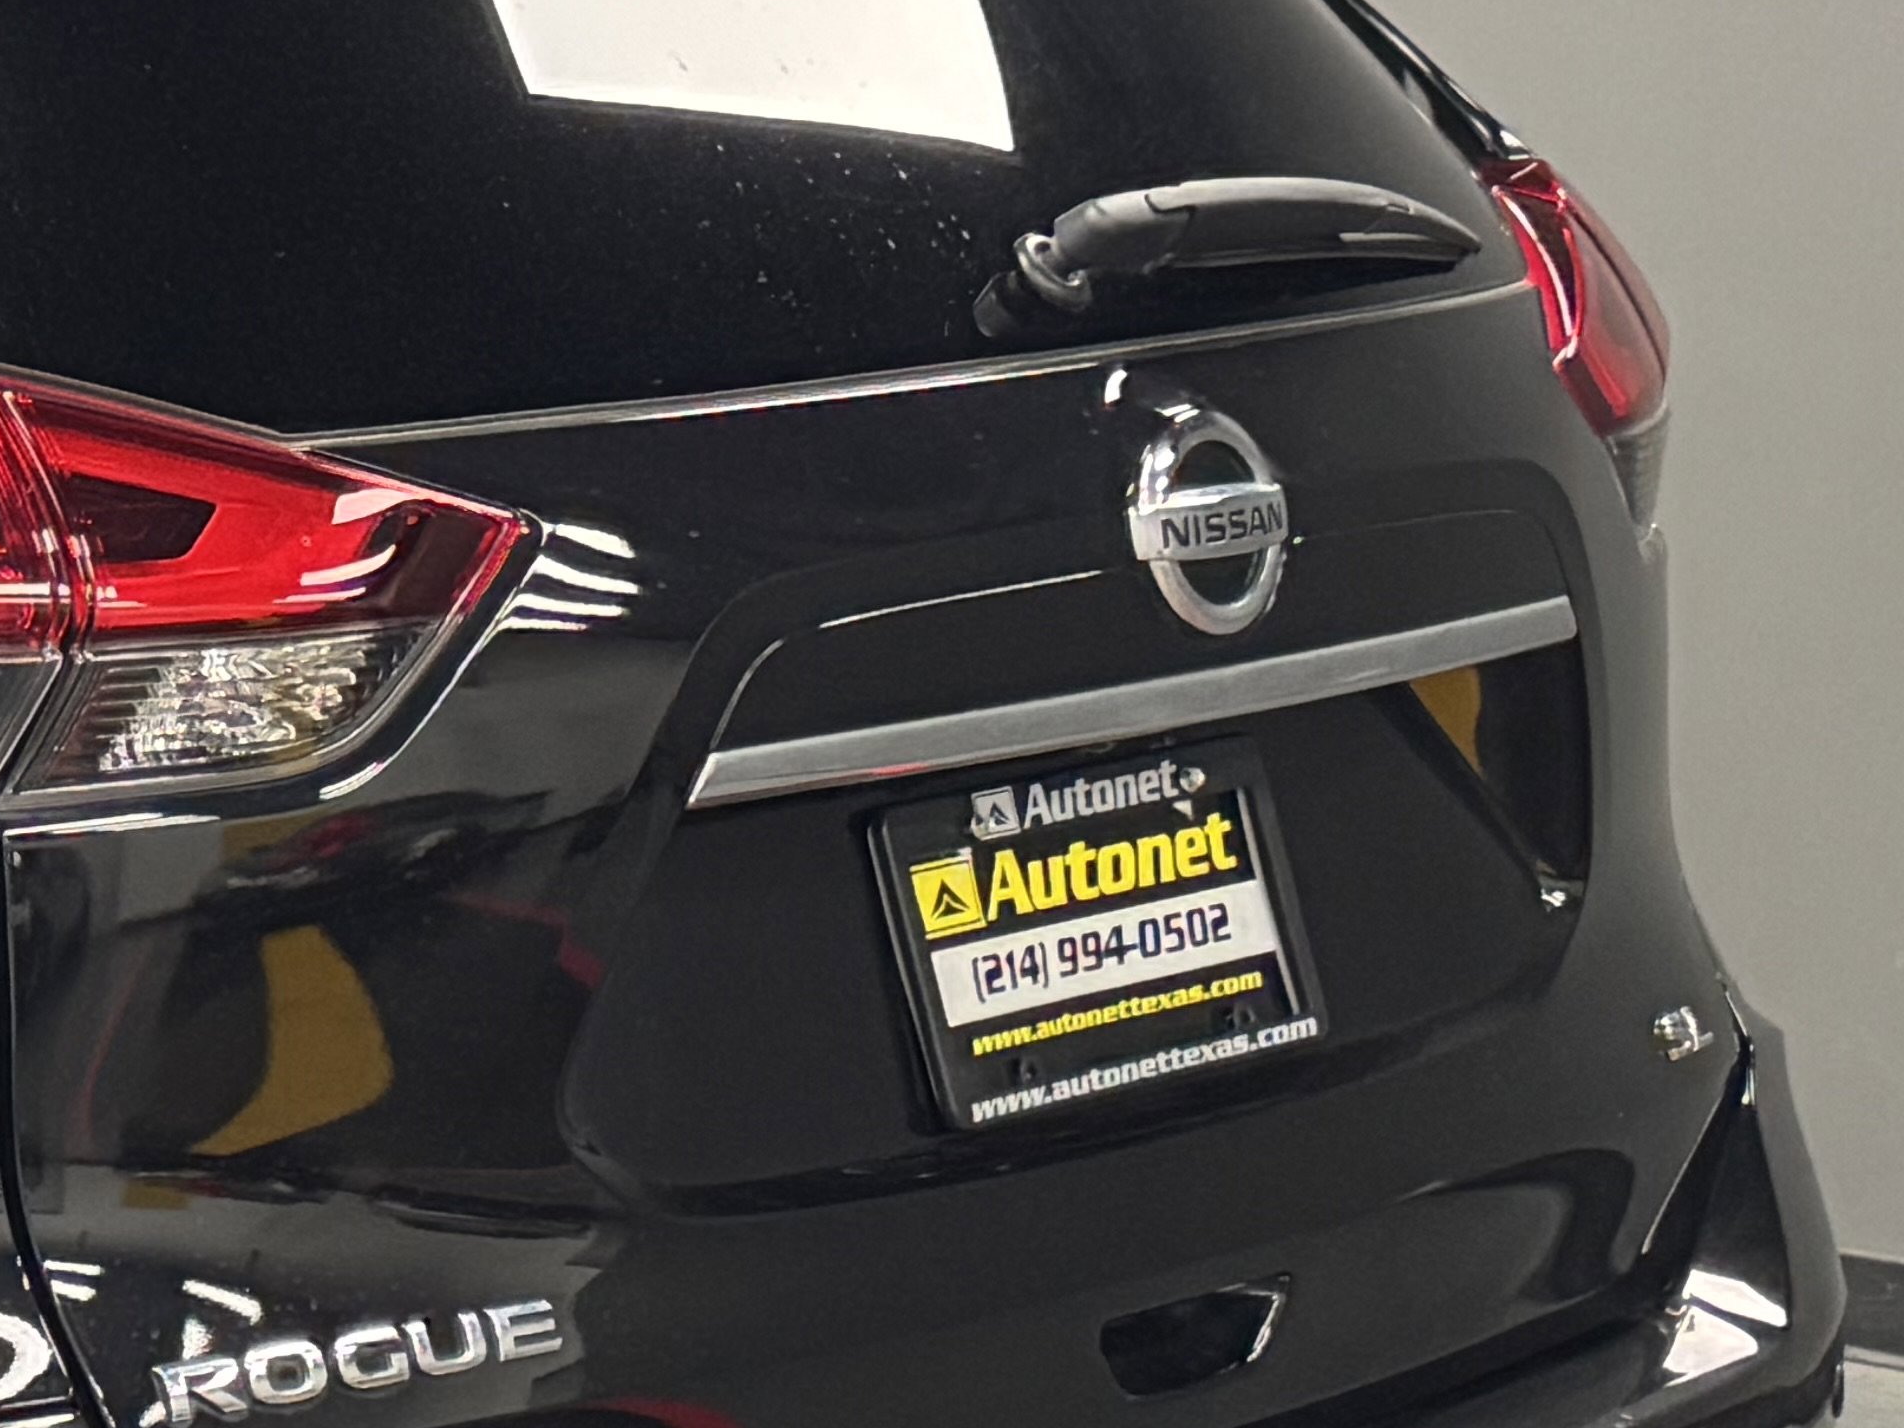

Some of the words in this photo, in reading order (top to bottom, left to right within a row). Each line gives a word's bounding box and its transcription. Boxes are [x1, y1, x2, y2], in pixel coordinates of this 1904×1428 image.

[1160, 501, 1283, 548] NISSAN
[1024, 759, 1178, 829] Autonet
[987, 812, 1238, 922] Autonet
[972, 942, 1050, 1004] (214)
[1058, 903, 1232, 978] 994-0502
[972, 971, 1263, 1056] www.autonettexas.com
[971, 1016, 1317, 1123] www.autonettexas.com
[152, 1298, 563, 1425] ROGUE
